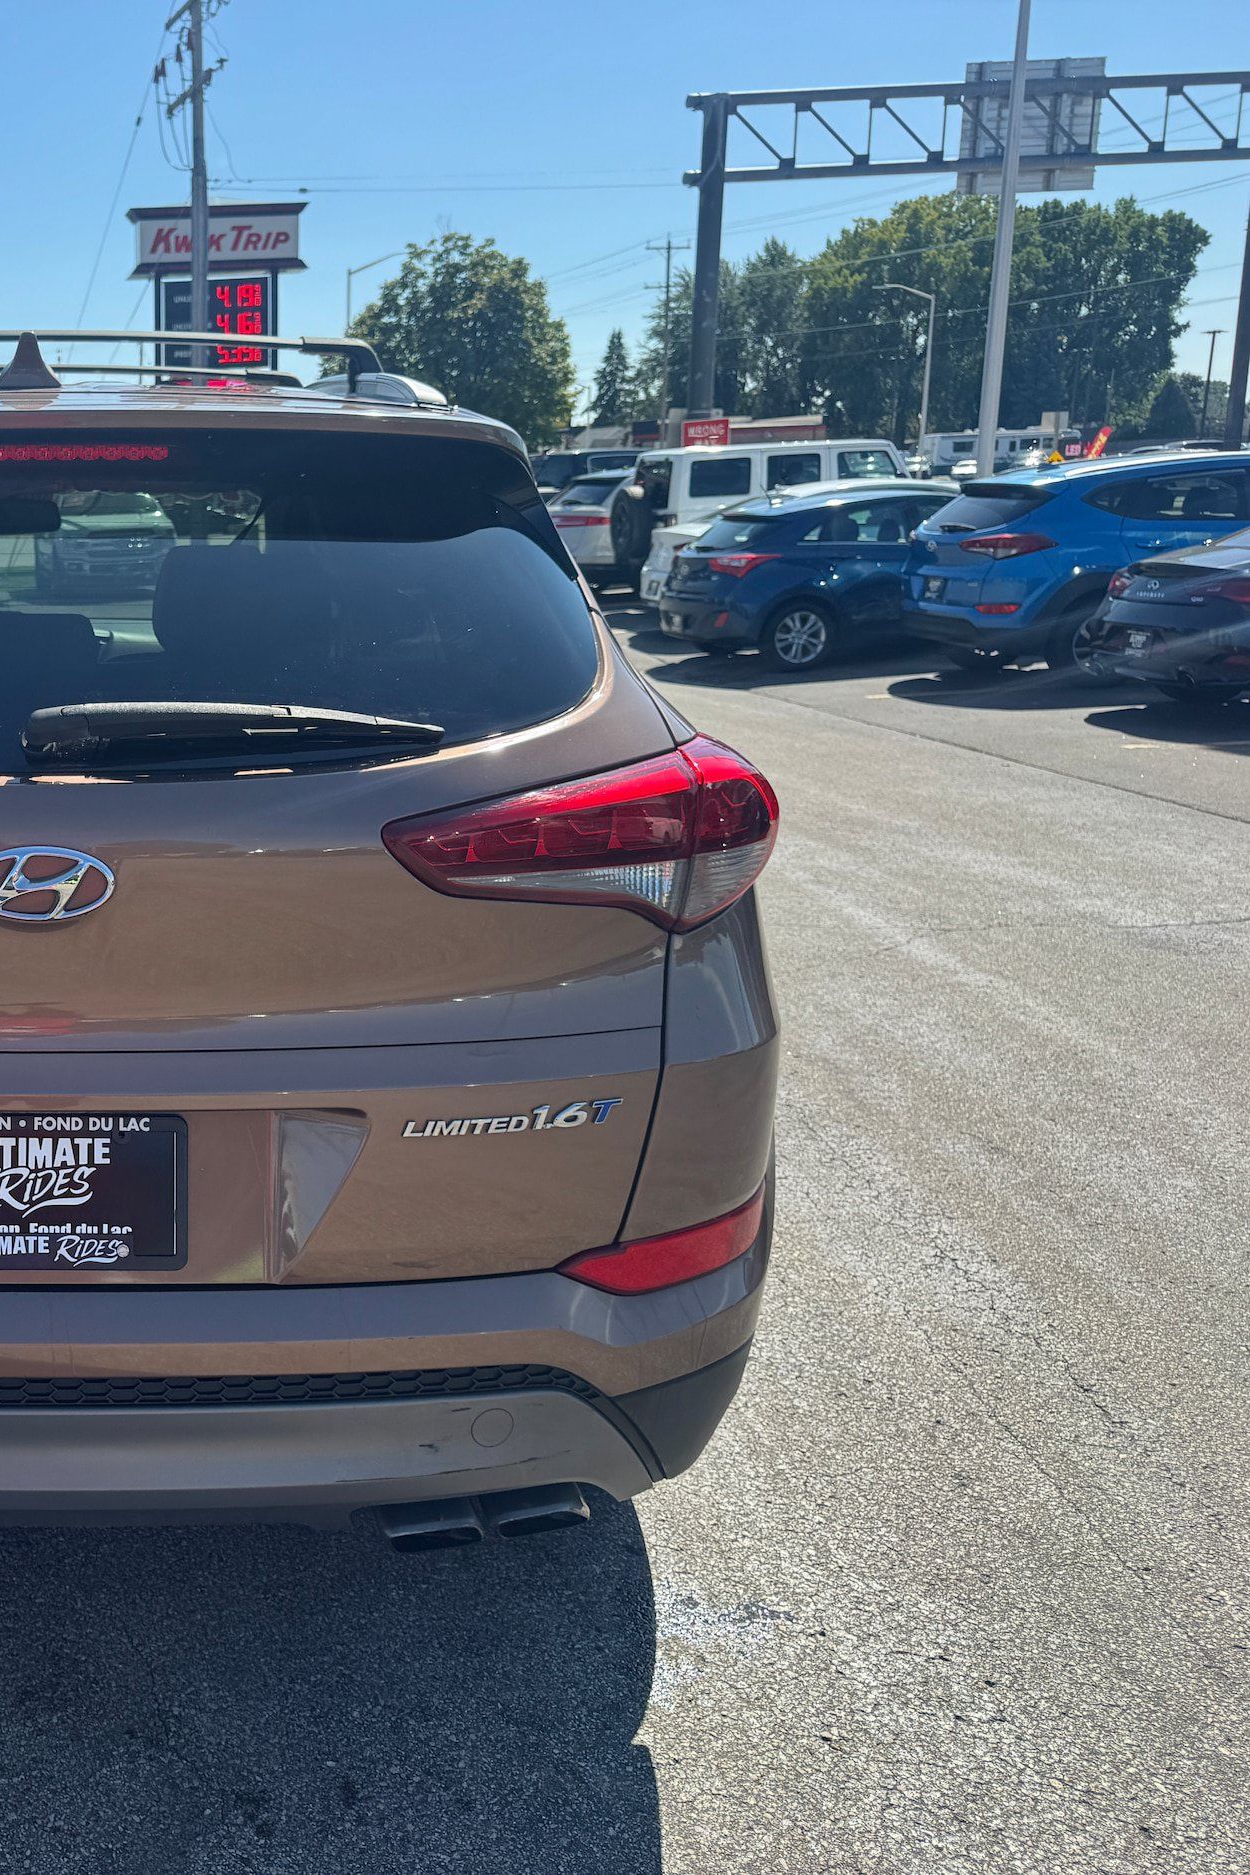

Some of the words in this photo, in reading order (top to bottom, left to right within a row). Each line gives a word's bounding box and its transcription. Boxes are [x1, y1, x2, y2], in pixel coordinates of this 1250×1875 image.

[150, 227, 227, 255] KWK
[687, 423, 725, 437] WRONG
[33, 1116, 84, 1132] FOND
[88, 1117, 114, 1132] DU
[118, 1117, 150, 1132] LAC
[402, 1115, 530, 1139] LIMITED
[75, 1222, 98, 1234] du
